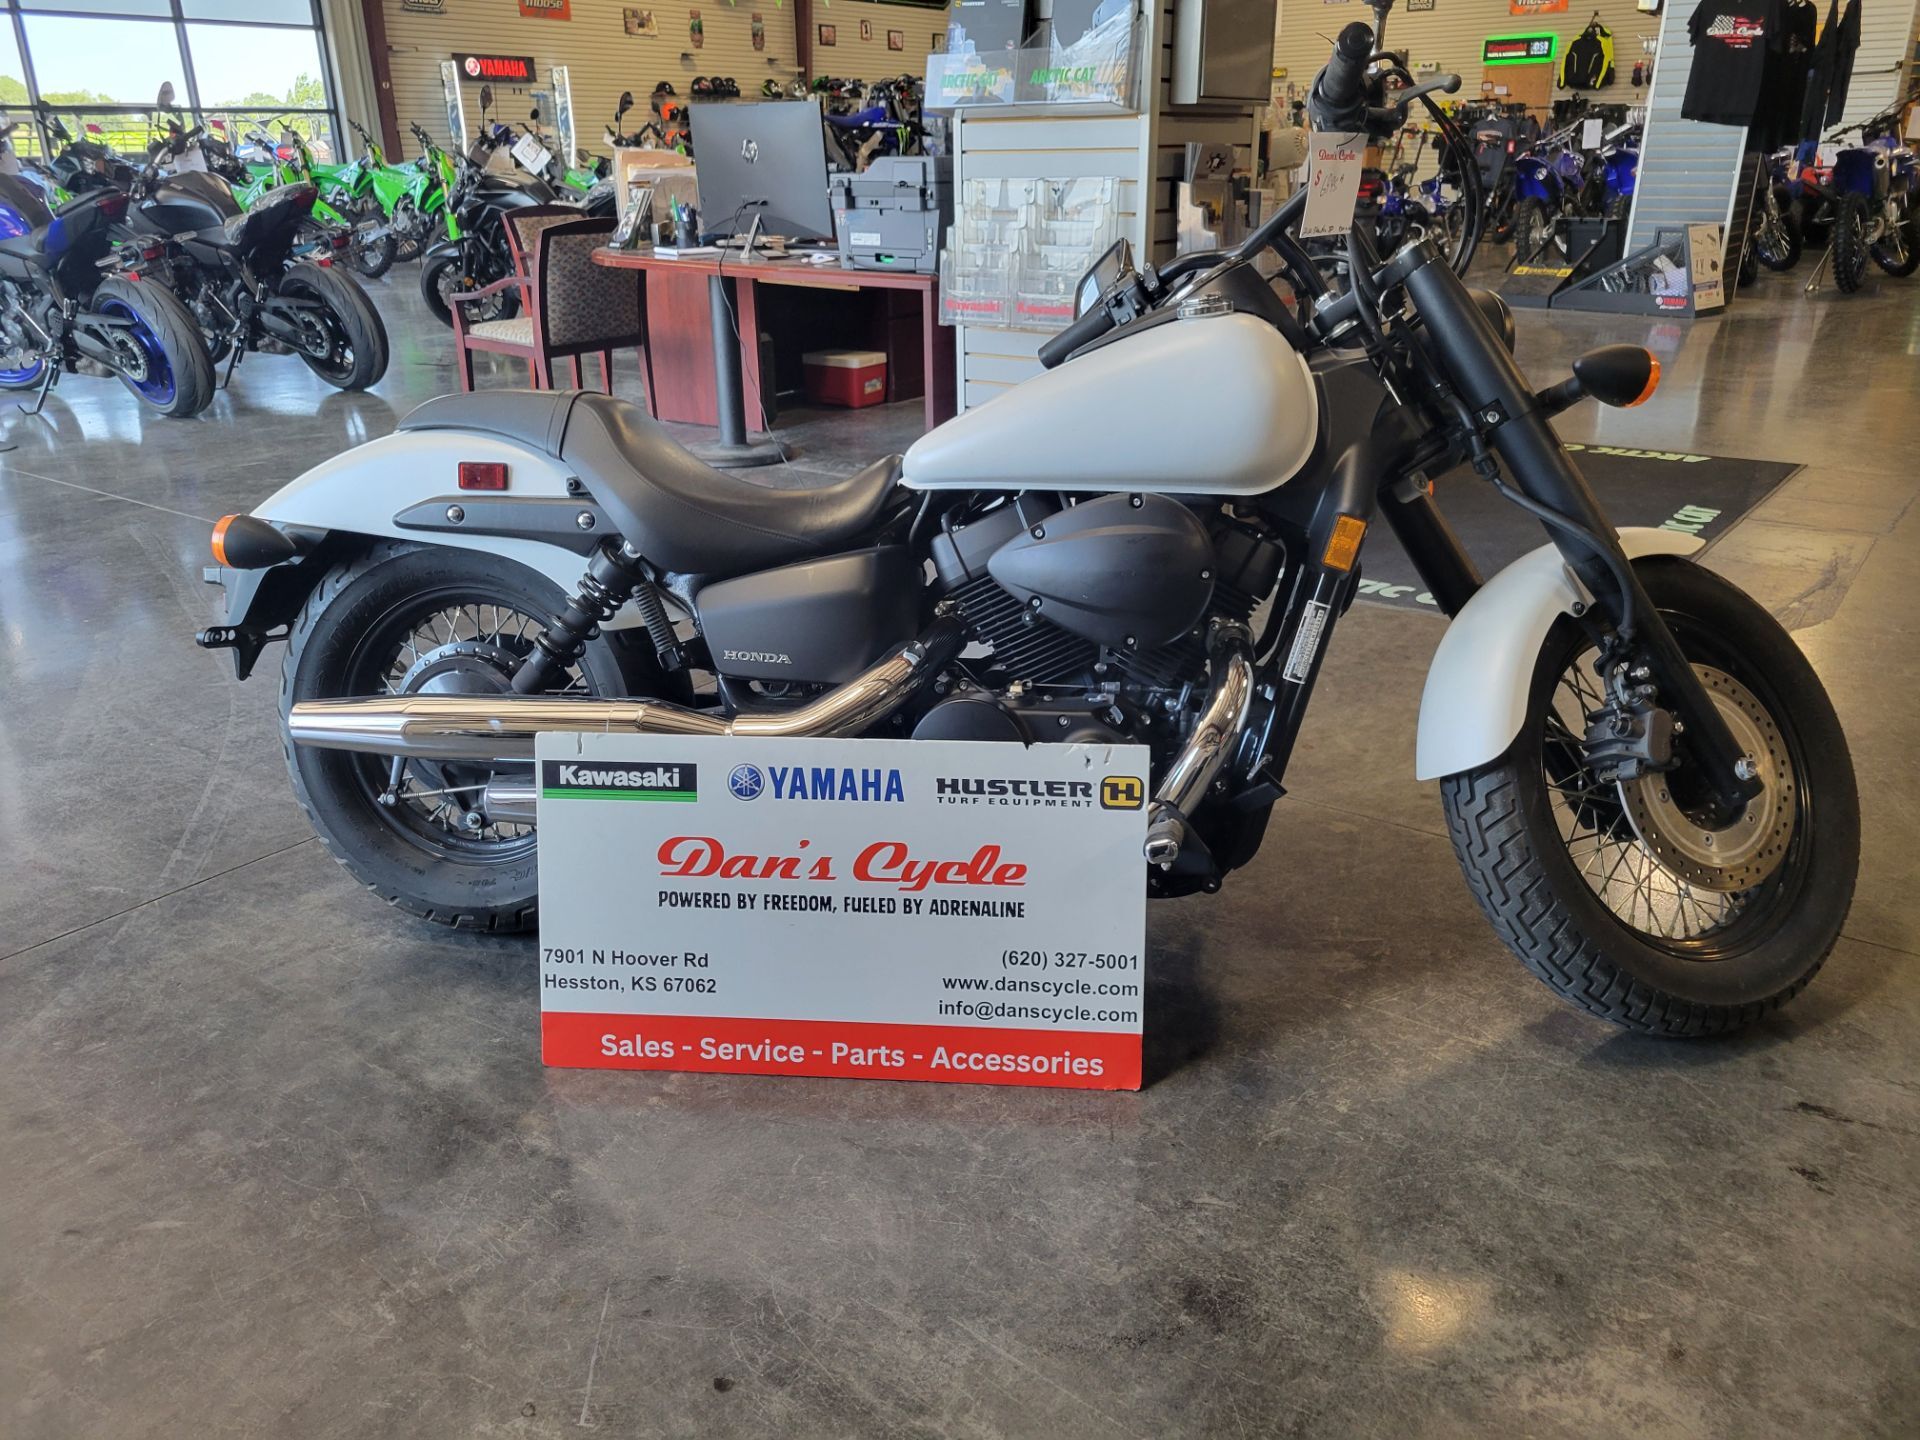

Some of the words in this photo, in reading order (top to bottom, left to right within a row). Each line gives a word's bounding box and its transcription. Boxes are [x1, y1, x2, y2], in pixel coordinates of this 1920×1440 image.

[479, 59, 527, 77] YAMAHA
[1030, 68, 1072, 84] ARCTIC
[1074, 66, 1096, 82] CAT
[723, 650, 792, 664] HONDA
[559, 765, 680, 788] Kawasaki
[768, 766, 904, 802] YAMAHA
[936, 778, 1092, 798] HUSTLER
[937, 796, 980, 805] TURF
[988, 797, 1093, 808] EQUIPMENT
[657, 836, 837, 881] Dan's
[853, 841, 1028, 891] Cycle
[658, 891, 731, 910] POWERED
[737, 893, 758, 910] BY
[764, 894, 837, 914] FREEDOM,
[844, 896, 896, 914] FUELED
[903, 898, 924, 915] BY
[929, 899, 1025, 919] ADRENALINE
[543, 948, 585, 964] 7901
[592, 950, 605, 965] N
[612, 950, 678, 967] Hoover
[684, 952, 709, 968] Rd
[1002, 950, 1048, 971] (620)
[1054, 952, 1138, 970] 327-5001
[544, 973, 625, 993] Hesston,
[631, 976, 657, 992] KS
[663, 977, 717, 994] 67062
[942, 976, 1138, 997] www.danscycle.com
[938, 1000, 1138, 1023] info@danscycle.com
[601, 1034, 675, 1058] Sales
[700, 1037, 805, 1063] Service
[831, 1042, 905, 1067] Parts
[930, 1046, 1104, 1076] Accessories
